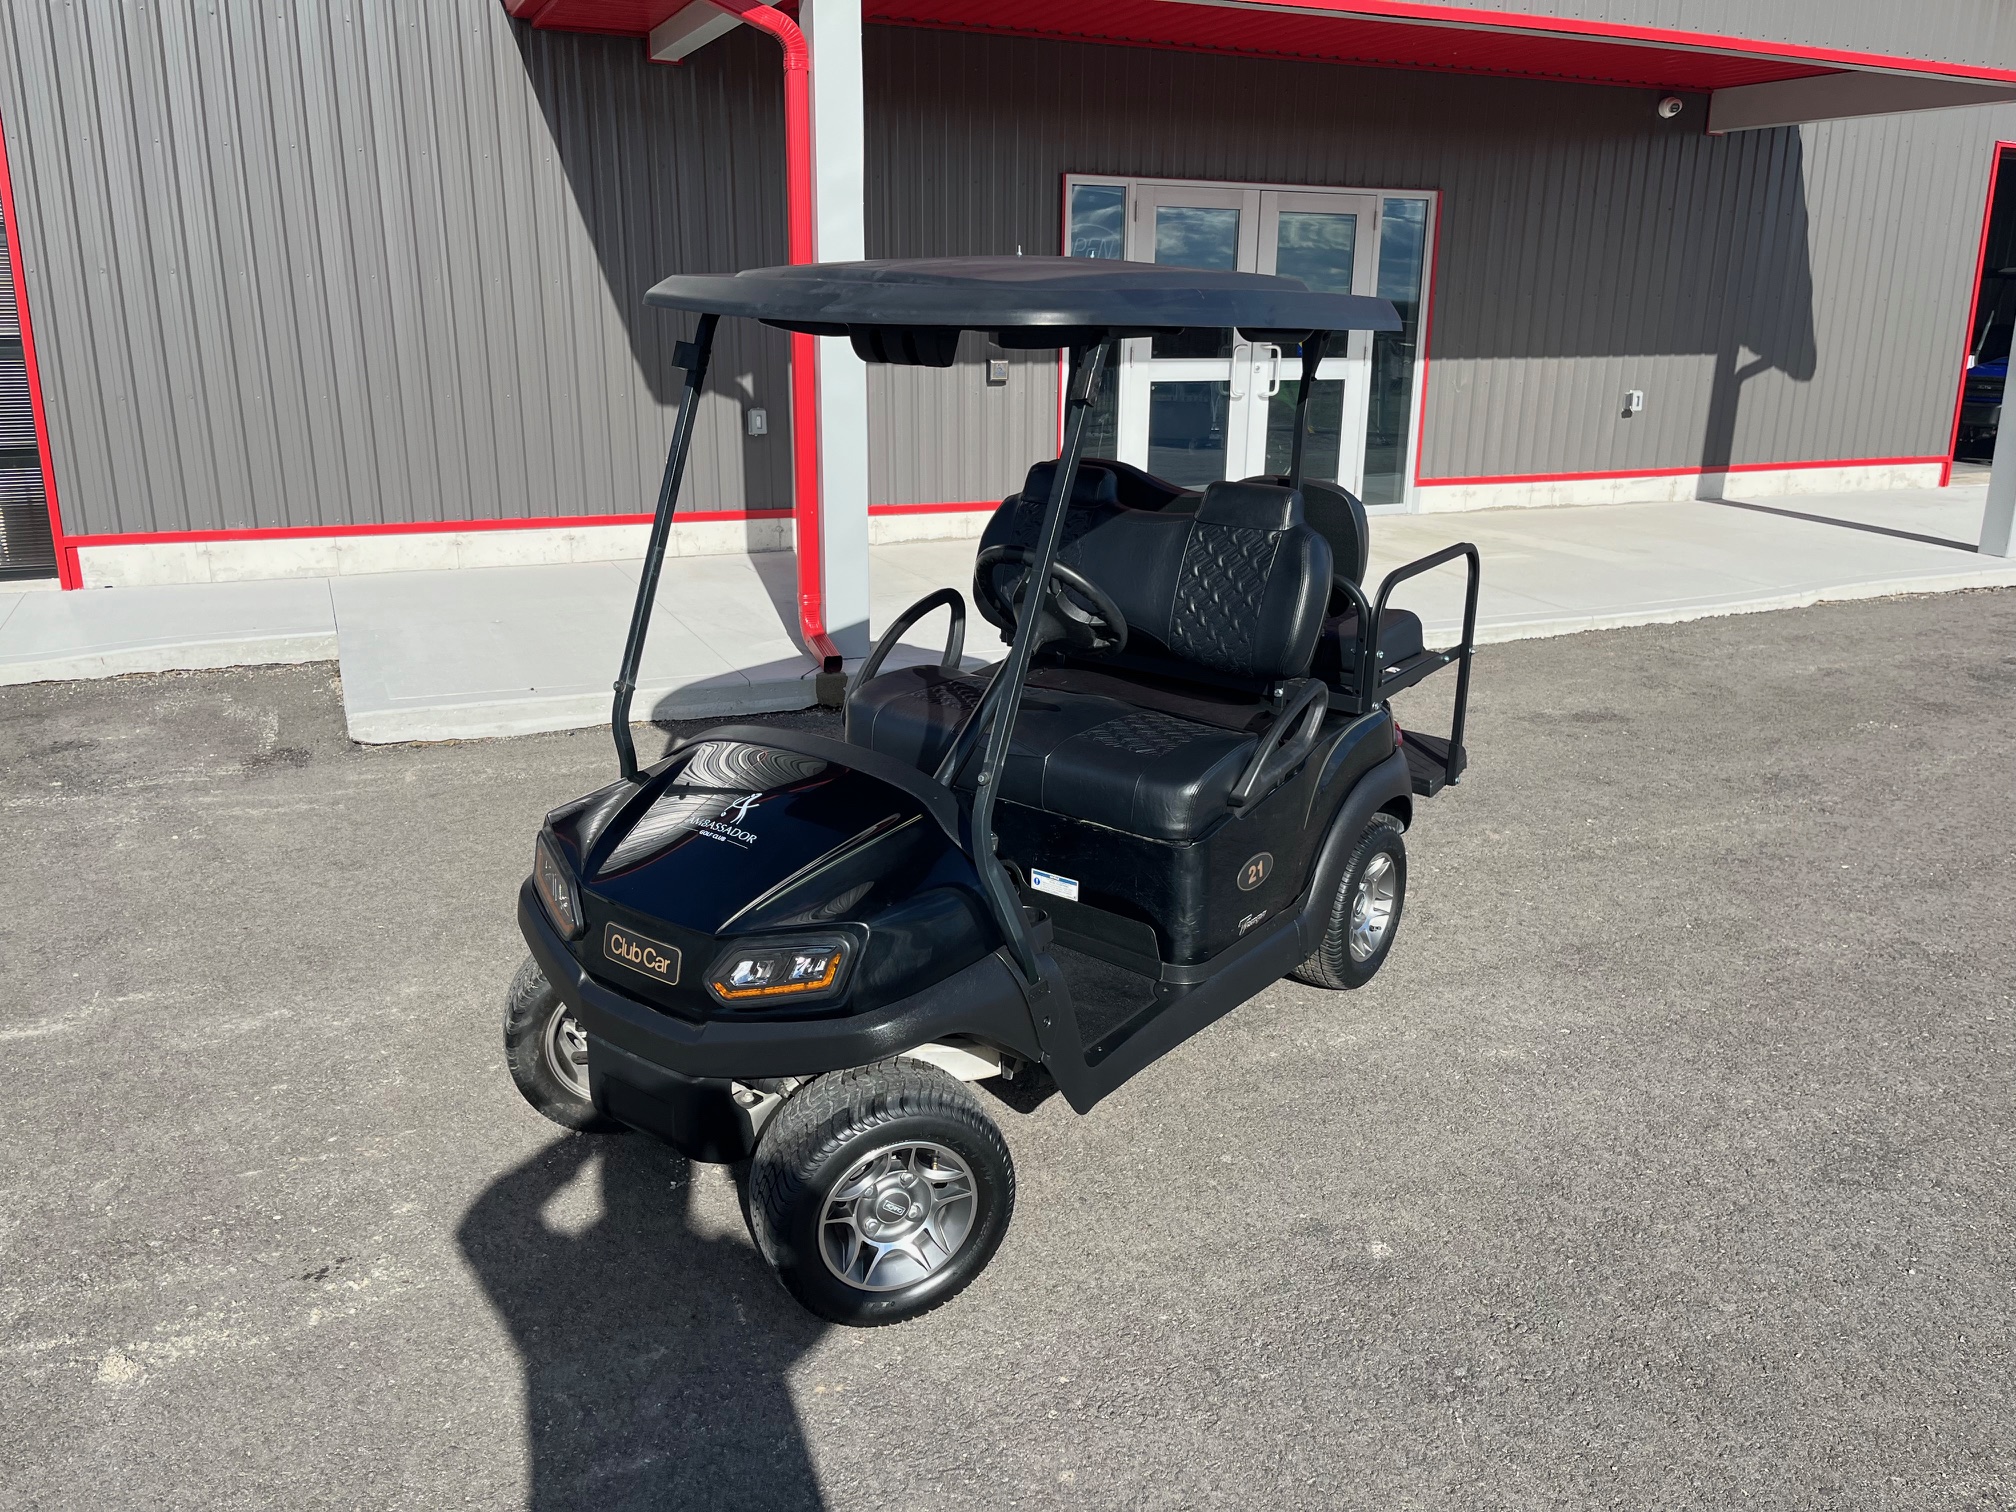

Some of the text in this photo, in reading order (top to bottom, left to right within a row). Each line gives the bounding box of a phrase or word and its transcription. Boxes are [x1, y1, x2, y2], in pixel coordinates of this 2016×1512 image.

[1072, 237, 1116, 259] PEN
[689, 816, 757, 844] AMBASSADOR
[1248, 859, 1263, 885] 21
[611, 933, 671, 974] Club Car
